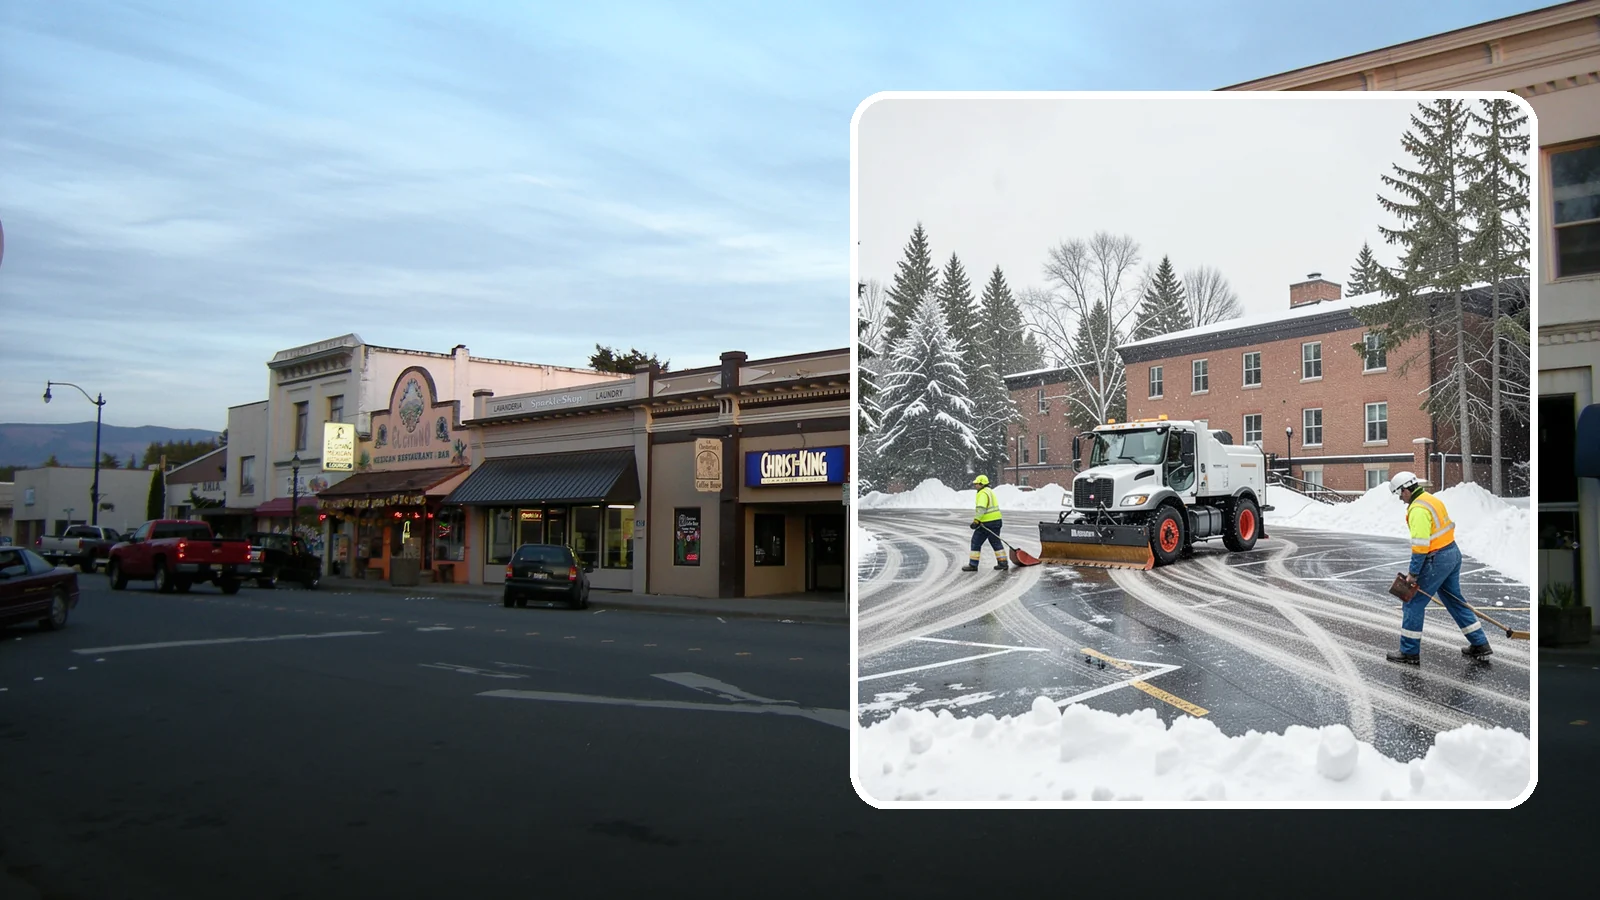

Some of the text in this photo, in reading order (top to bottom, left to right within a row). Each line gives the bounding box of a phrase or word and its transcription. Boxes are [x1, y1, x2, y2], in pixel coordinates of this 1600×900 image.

[595, 389, 624, 400] LAUNDRY
[493, 394, 583, 413] LAVANDERIA Sparkle Shop
[327, 449, 352, 457] MEXICAN
[373, 455, 397, 465] MEXICAN
[397, 452, 434, 462] RESTAURANT
[438, 449, 450, 460] BAR
[760, 450, 828, 478] CHRIST KING
[696, 480, 709, 489] Coffee
